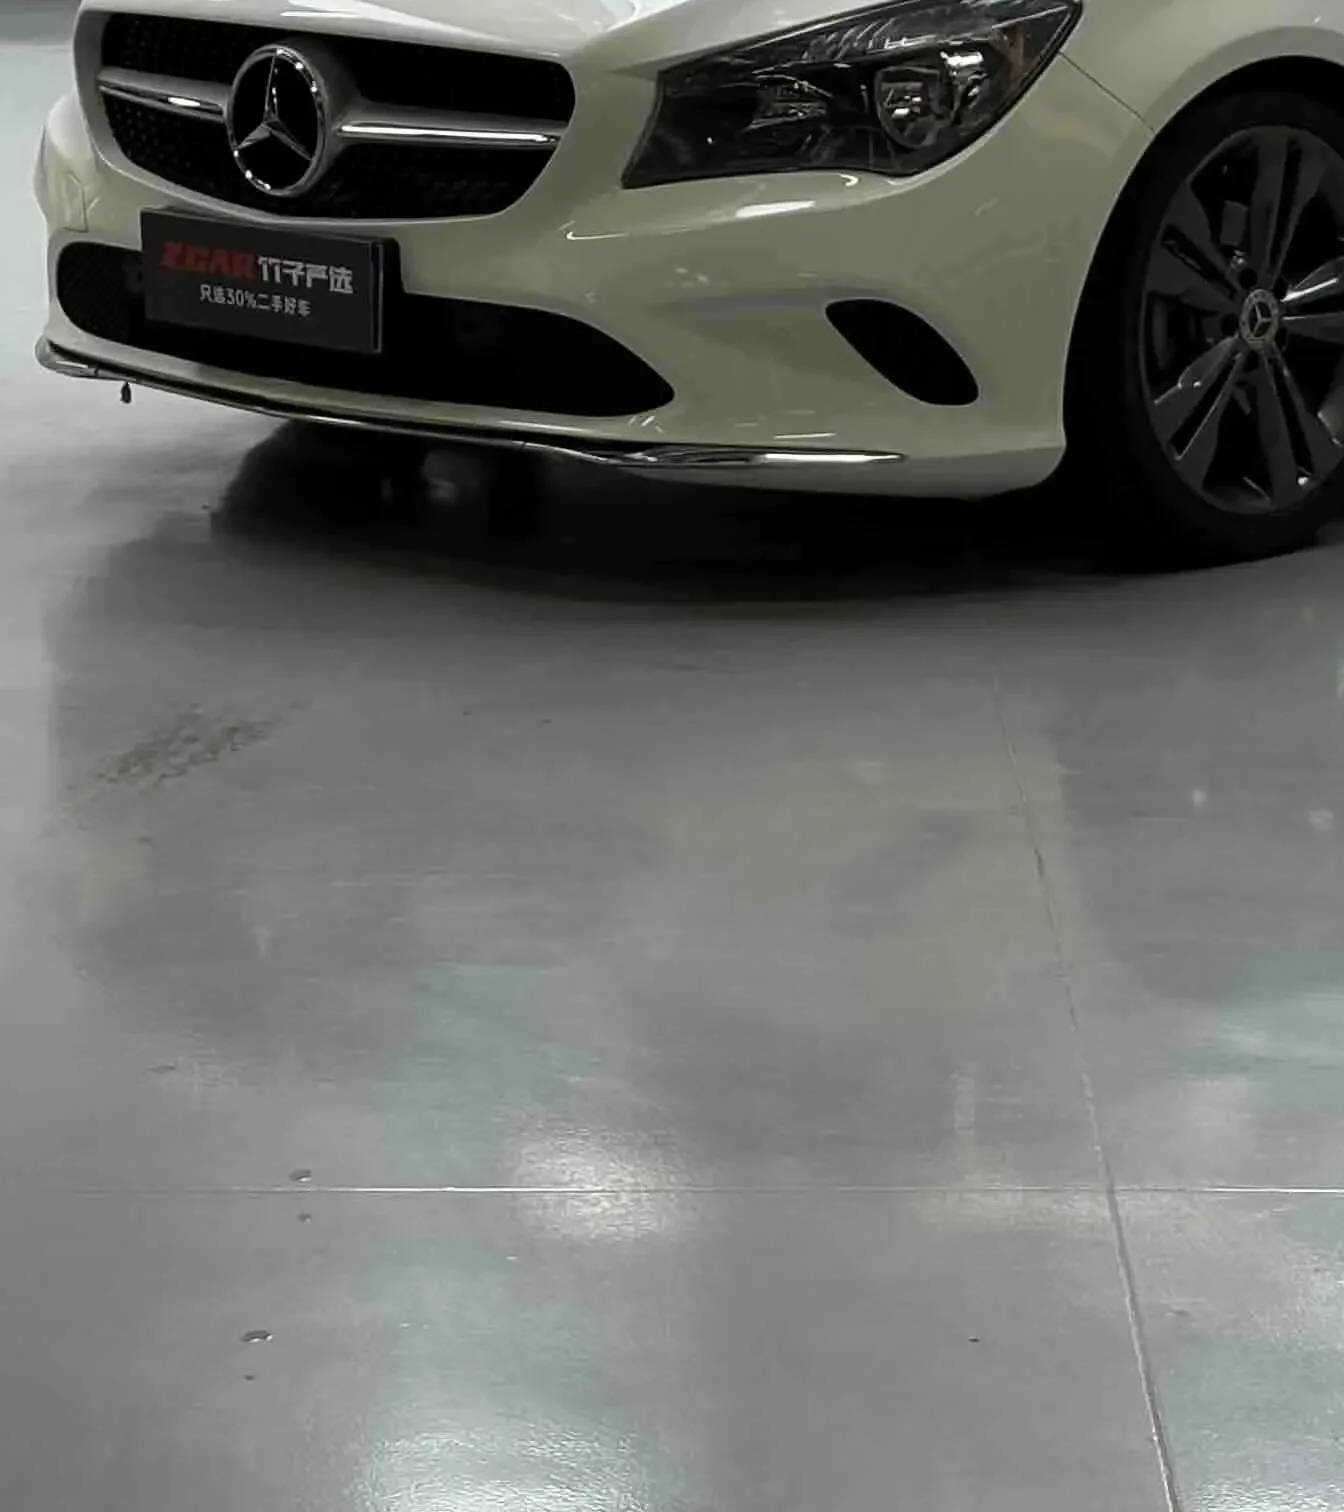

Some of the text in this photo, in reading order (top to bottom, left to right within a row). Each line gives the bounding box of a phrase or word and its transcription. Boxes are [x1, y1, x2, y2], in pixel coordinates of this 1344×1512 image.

[159, 240, 354, 295] ZCAR 竹子严选
